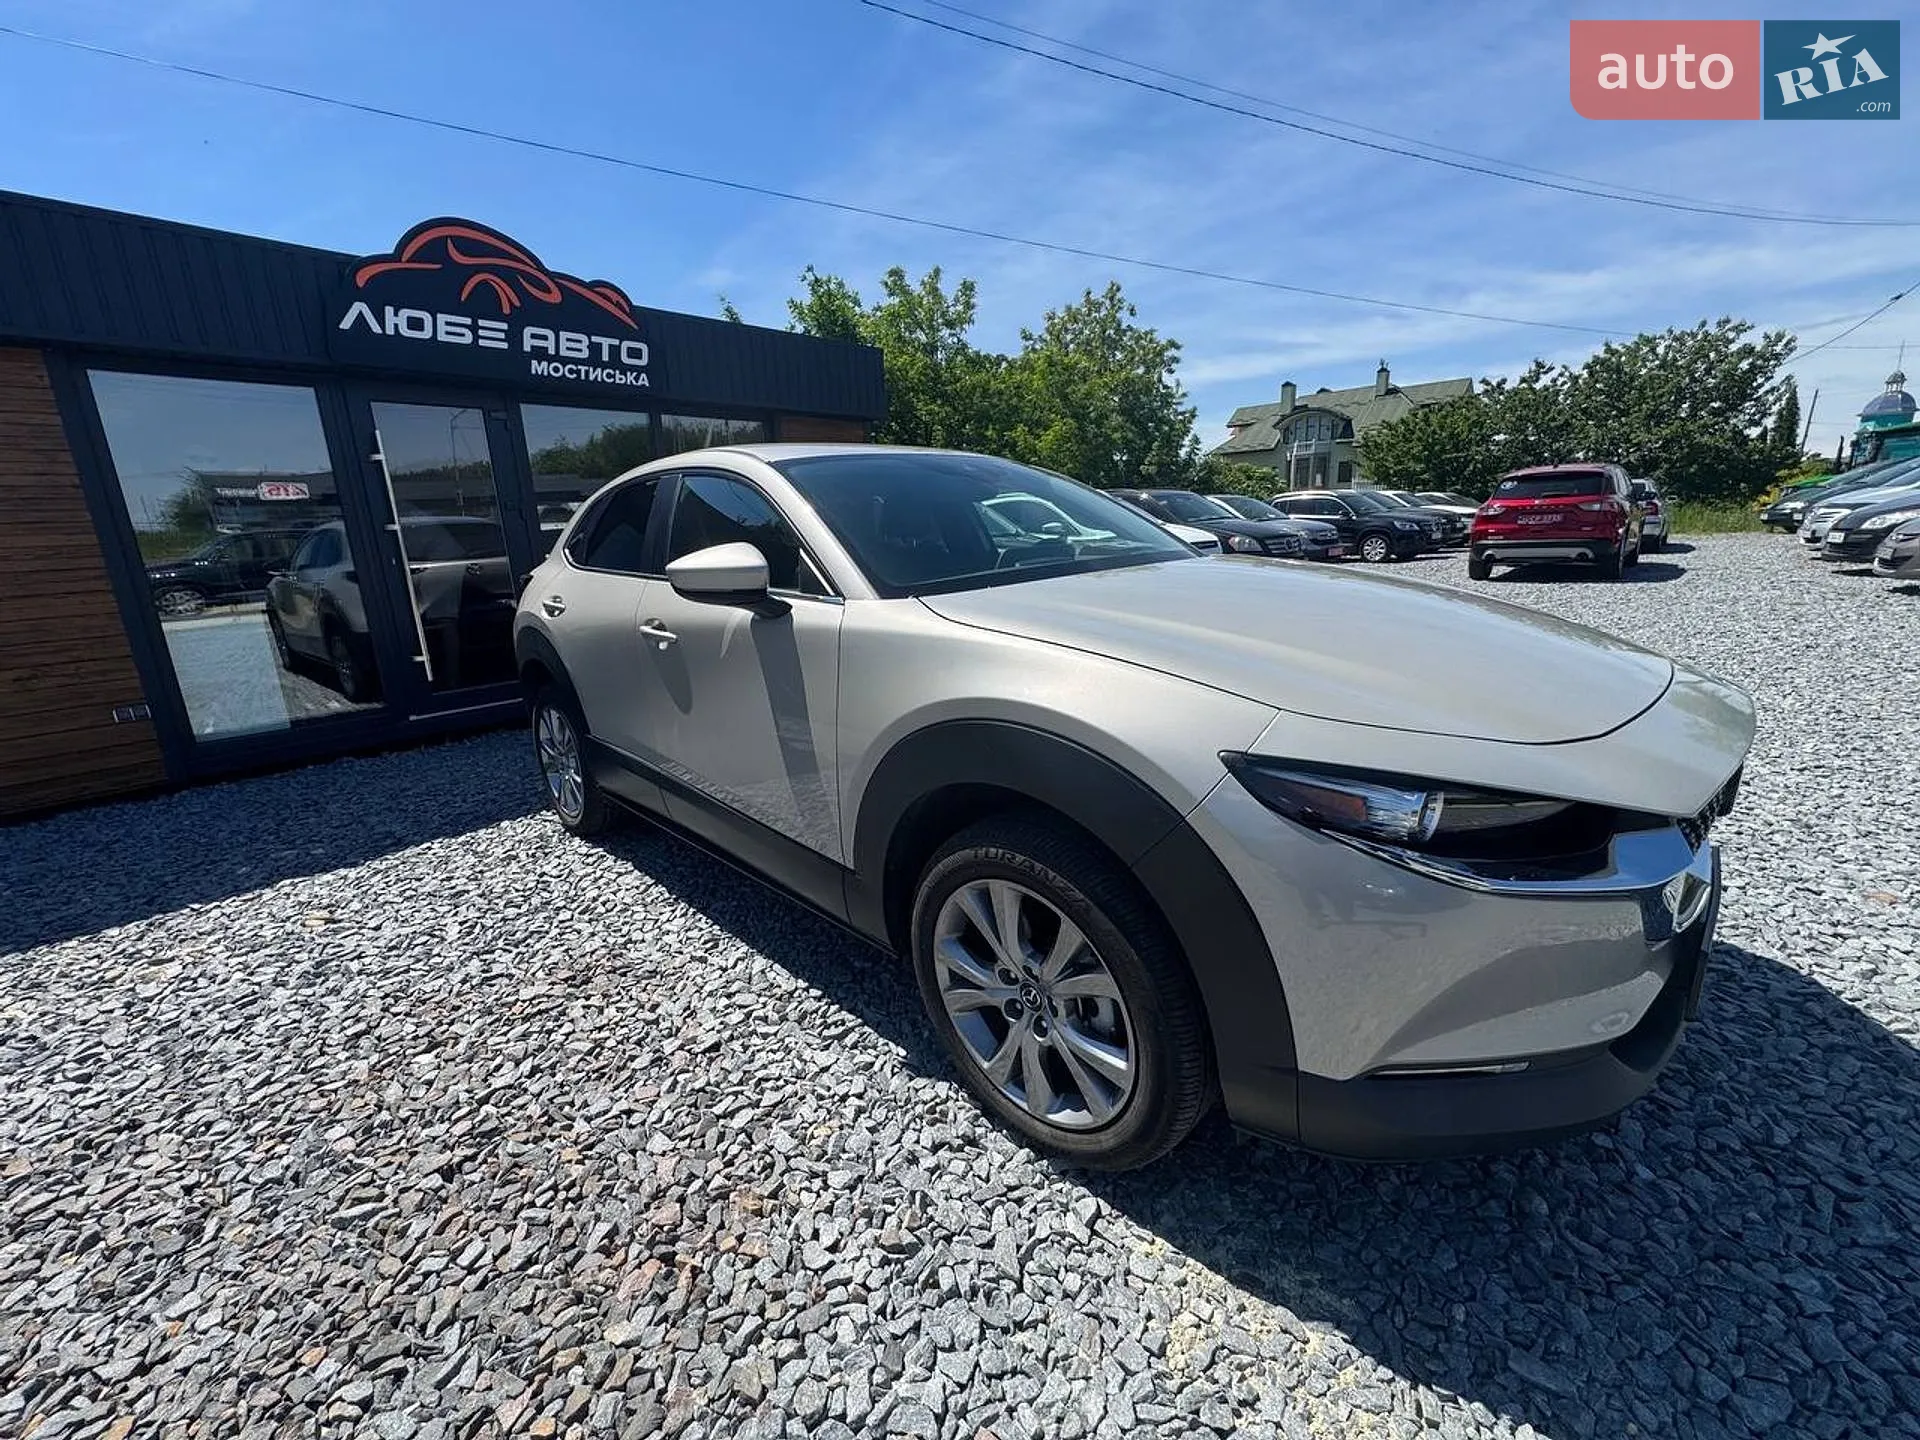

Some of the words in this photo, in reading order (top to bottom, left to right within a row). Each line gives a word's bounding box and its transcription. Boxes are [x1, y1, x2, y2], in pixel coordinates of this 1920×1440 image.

[339, 301, 509, 350] ЛЮБЕ
[522, 326, 649, 366] АВТО
[530, 359, 650, 388] МОСТИСЬКА
